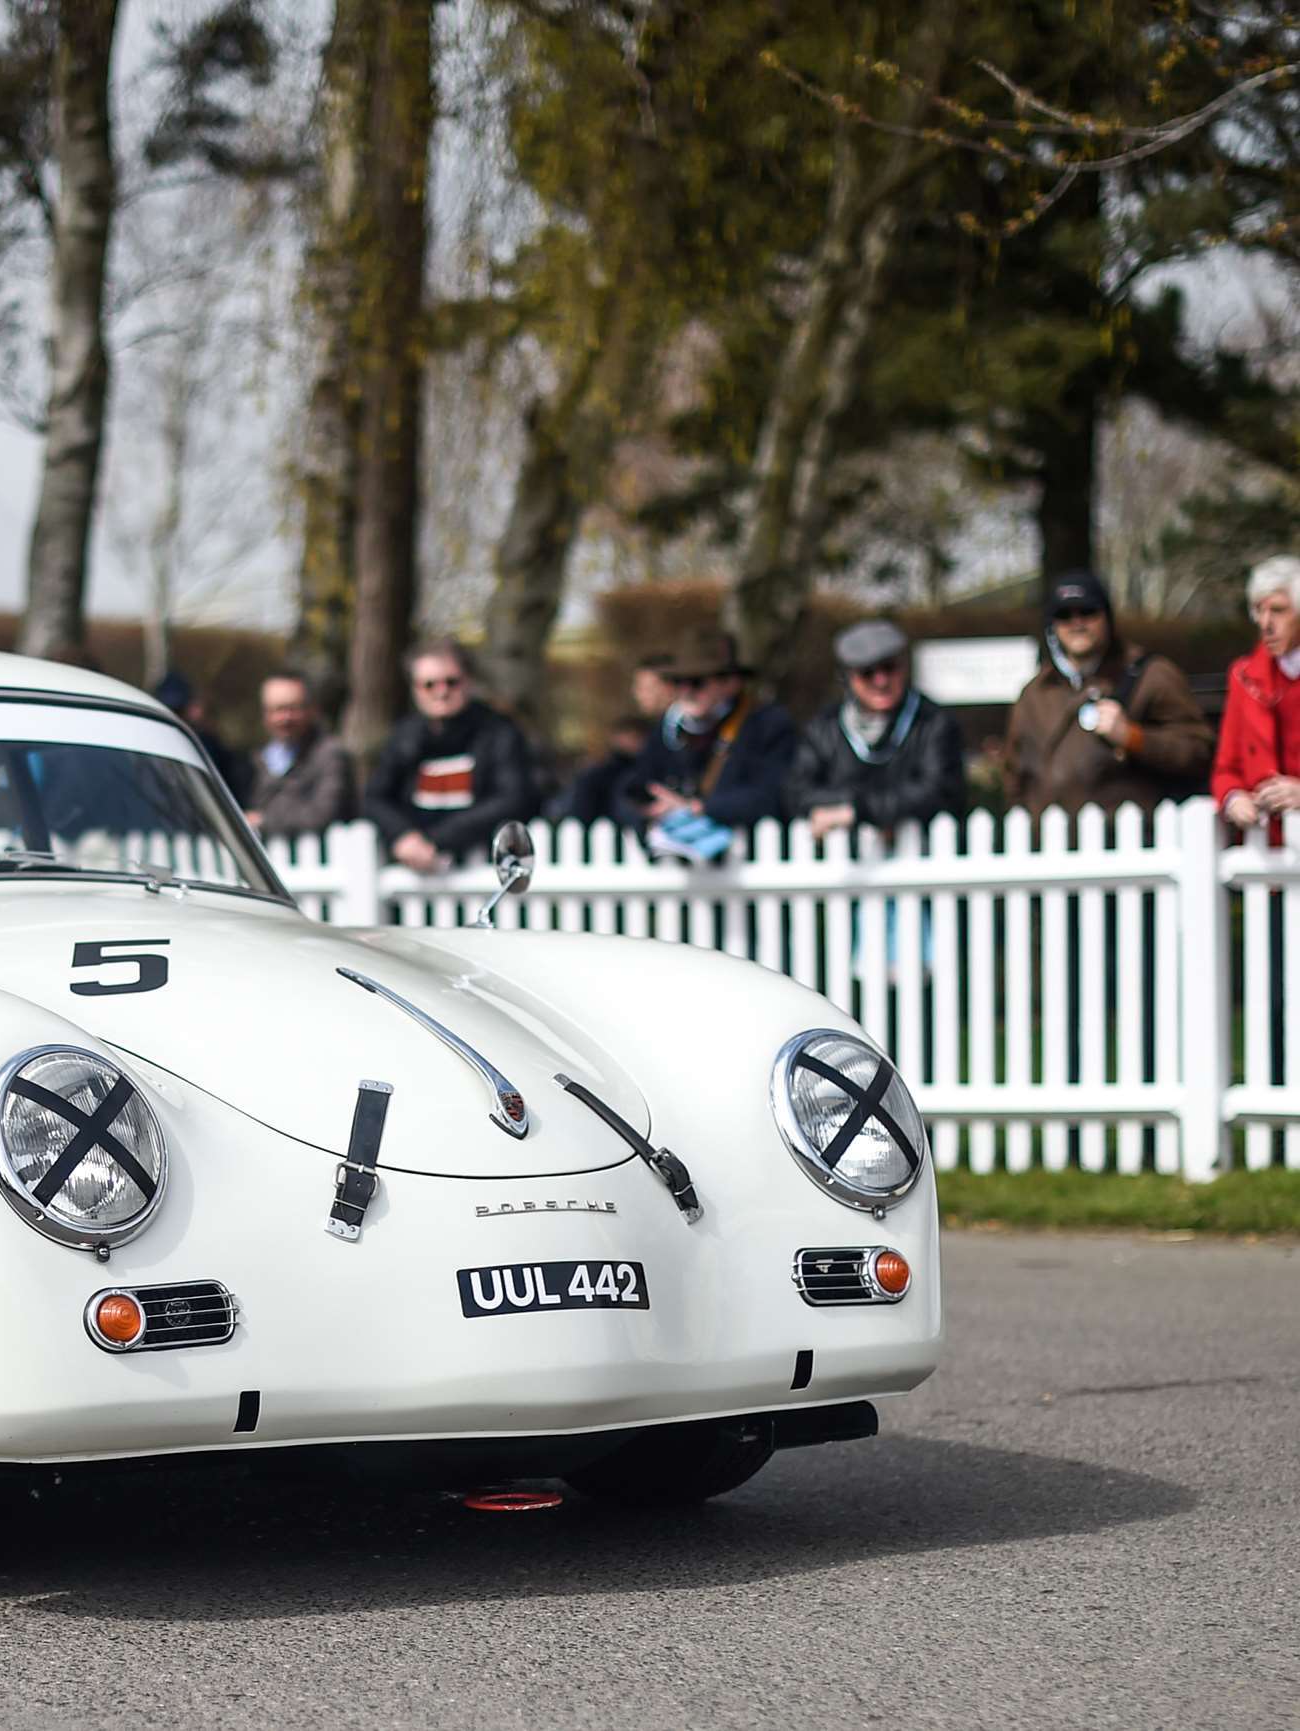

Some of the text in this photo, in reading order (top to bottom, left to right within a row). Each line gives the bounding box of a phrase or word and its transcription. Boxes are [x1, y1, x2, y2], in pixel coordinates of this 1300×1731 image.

[70, 939, 170, 996] 5
[475, 1200, 618, 1217] PORSCHE
[470, 1264, 640, 1310] UUL 442
